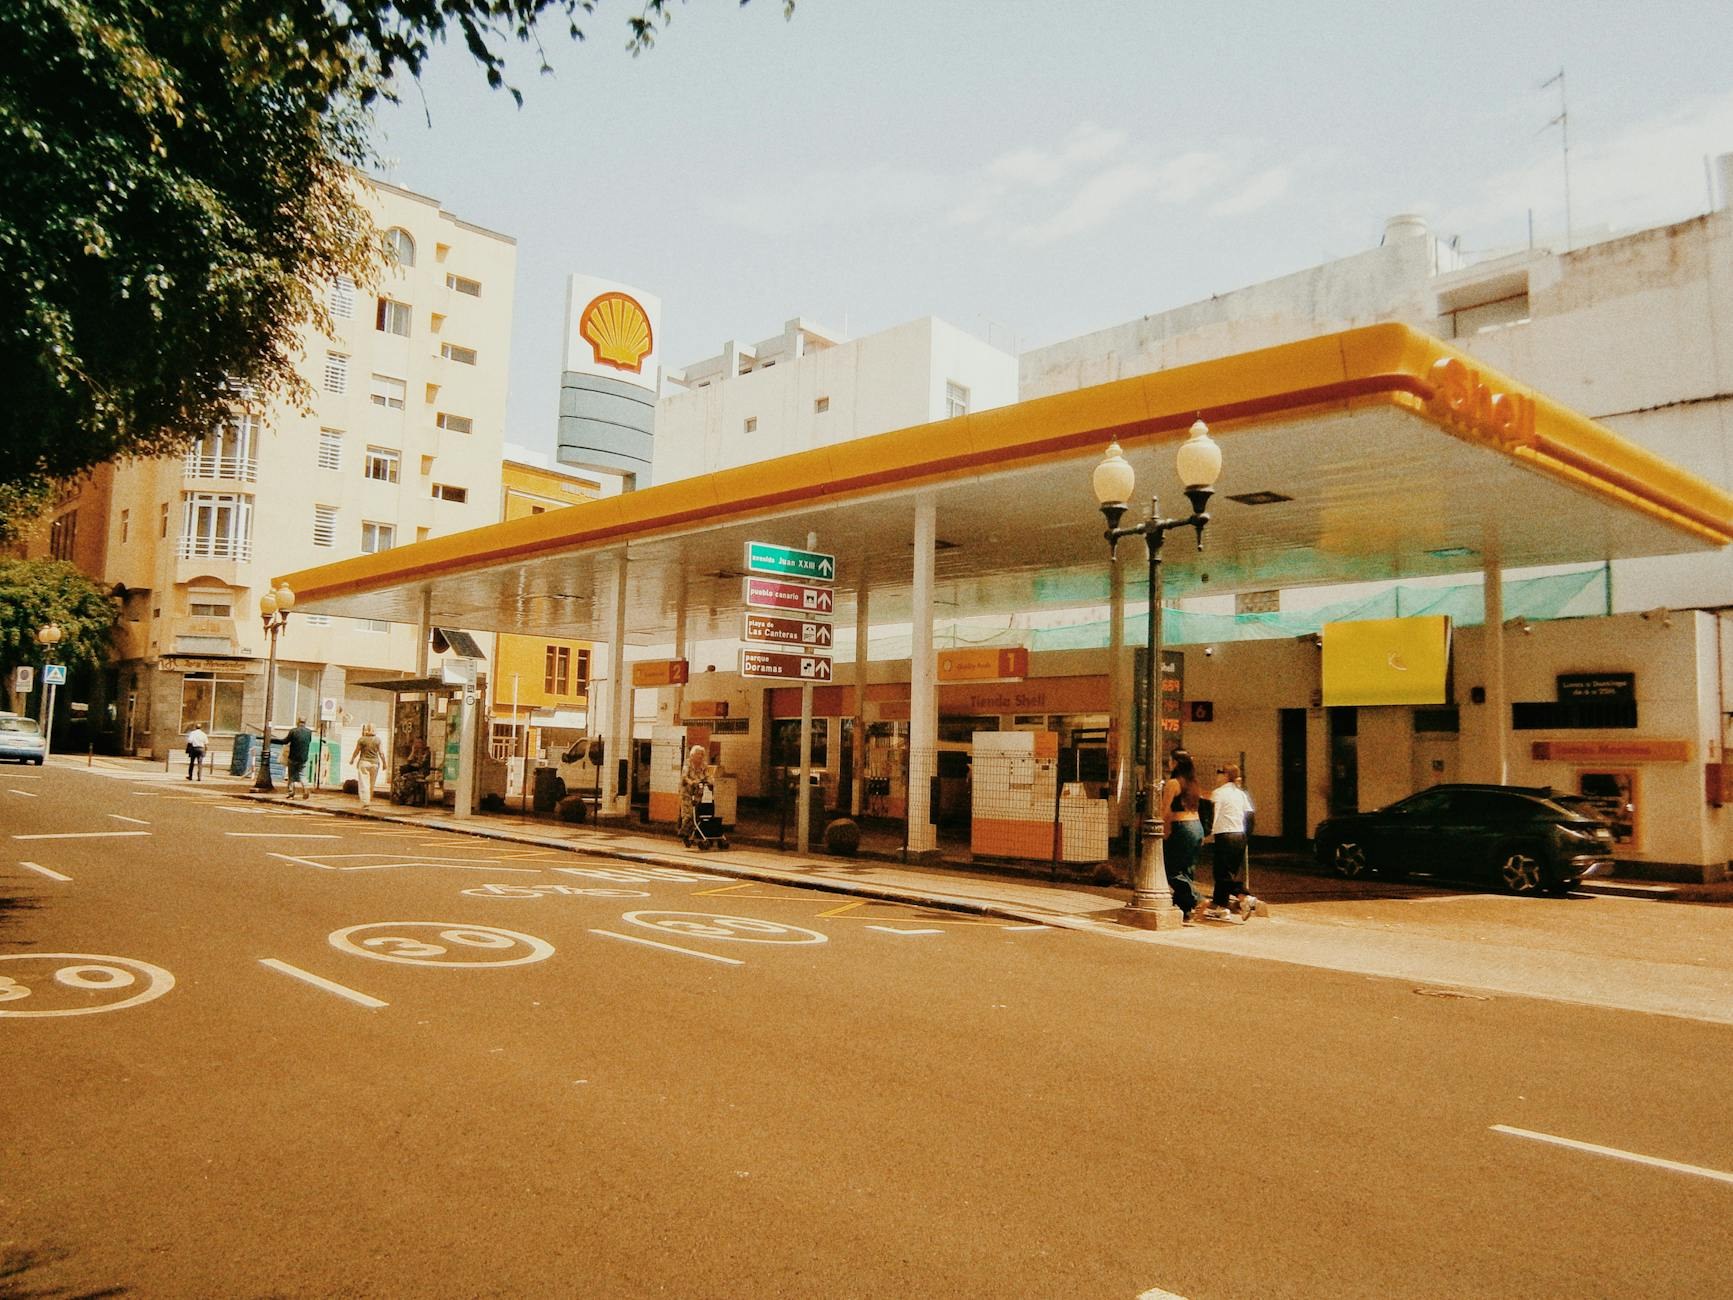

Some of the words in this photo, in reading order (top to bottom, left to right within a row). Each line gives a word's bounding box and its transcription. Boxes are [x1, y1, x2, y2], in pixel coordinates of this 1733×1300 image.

[778, 557, 796, 567] Juan
[798, 559, 815, 569] XXIII
[750, 588, 773, 597] pueblo
[775, 591, 799, 600] canario
[749, 620, 765, 628] playa
[748, 627, 762, 635] Las
[764, 628, 799, 640] Canteras
[745, 661, 783, 674] Doramas
[1007, 652, 1016, 673] 1
[673, 665, 681, 680] 2
[970, 693, 1011, 708] Tienda
[1015, 692, 1046, 707] Shell
[655, 917, 788, 936] 30
[364, 929, 516, 957] 30
